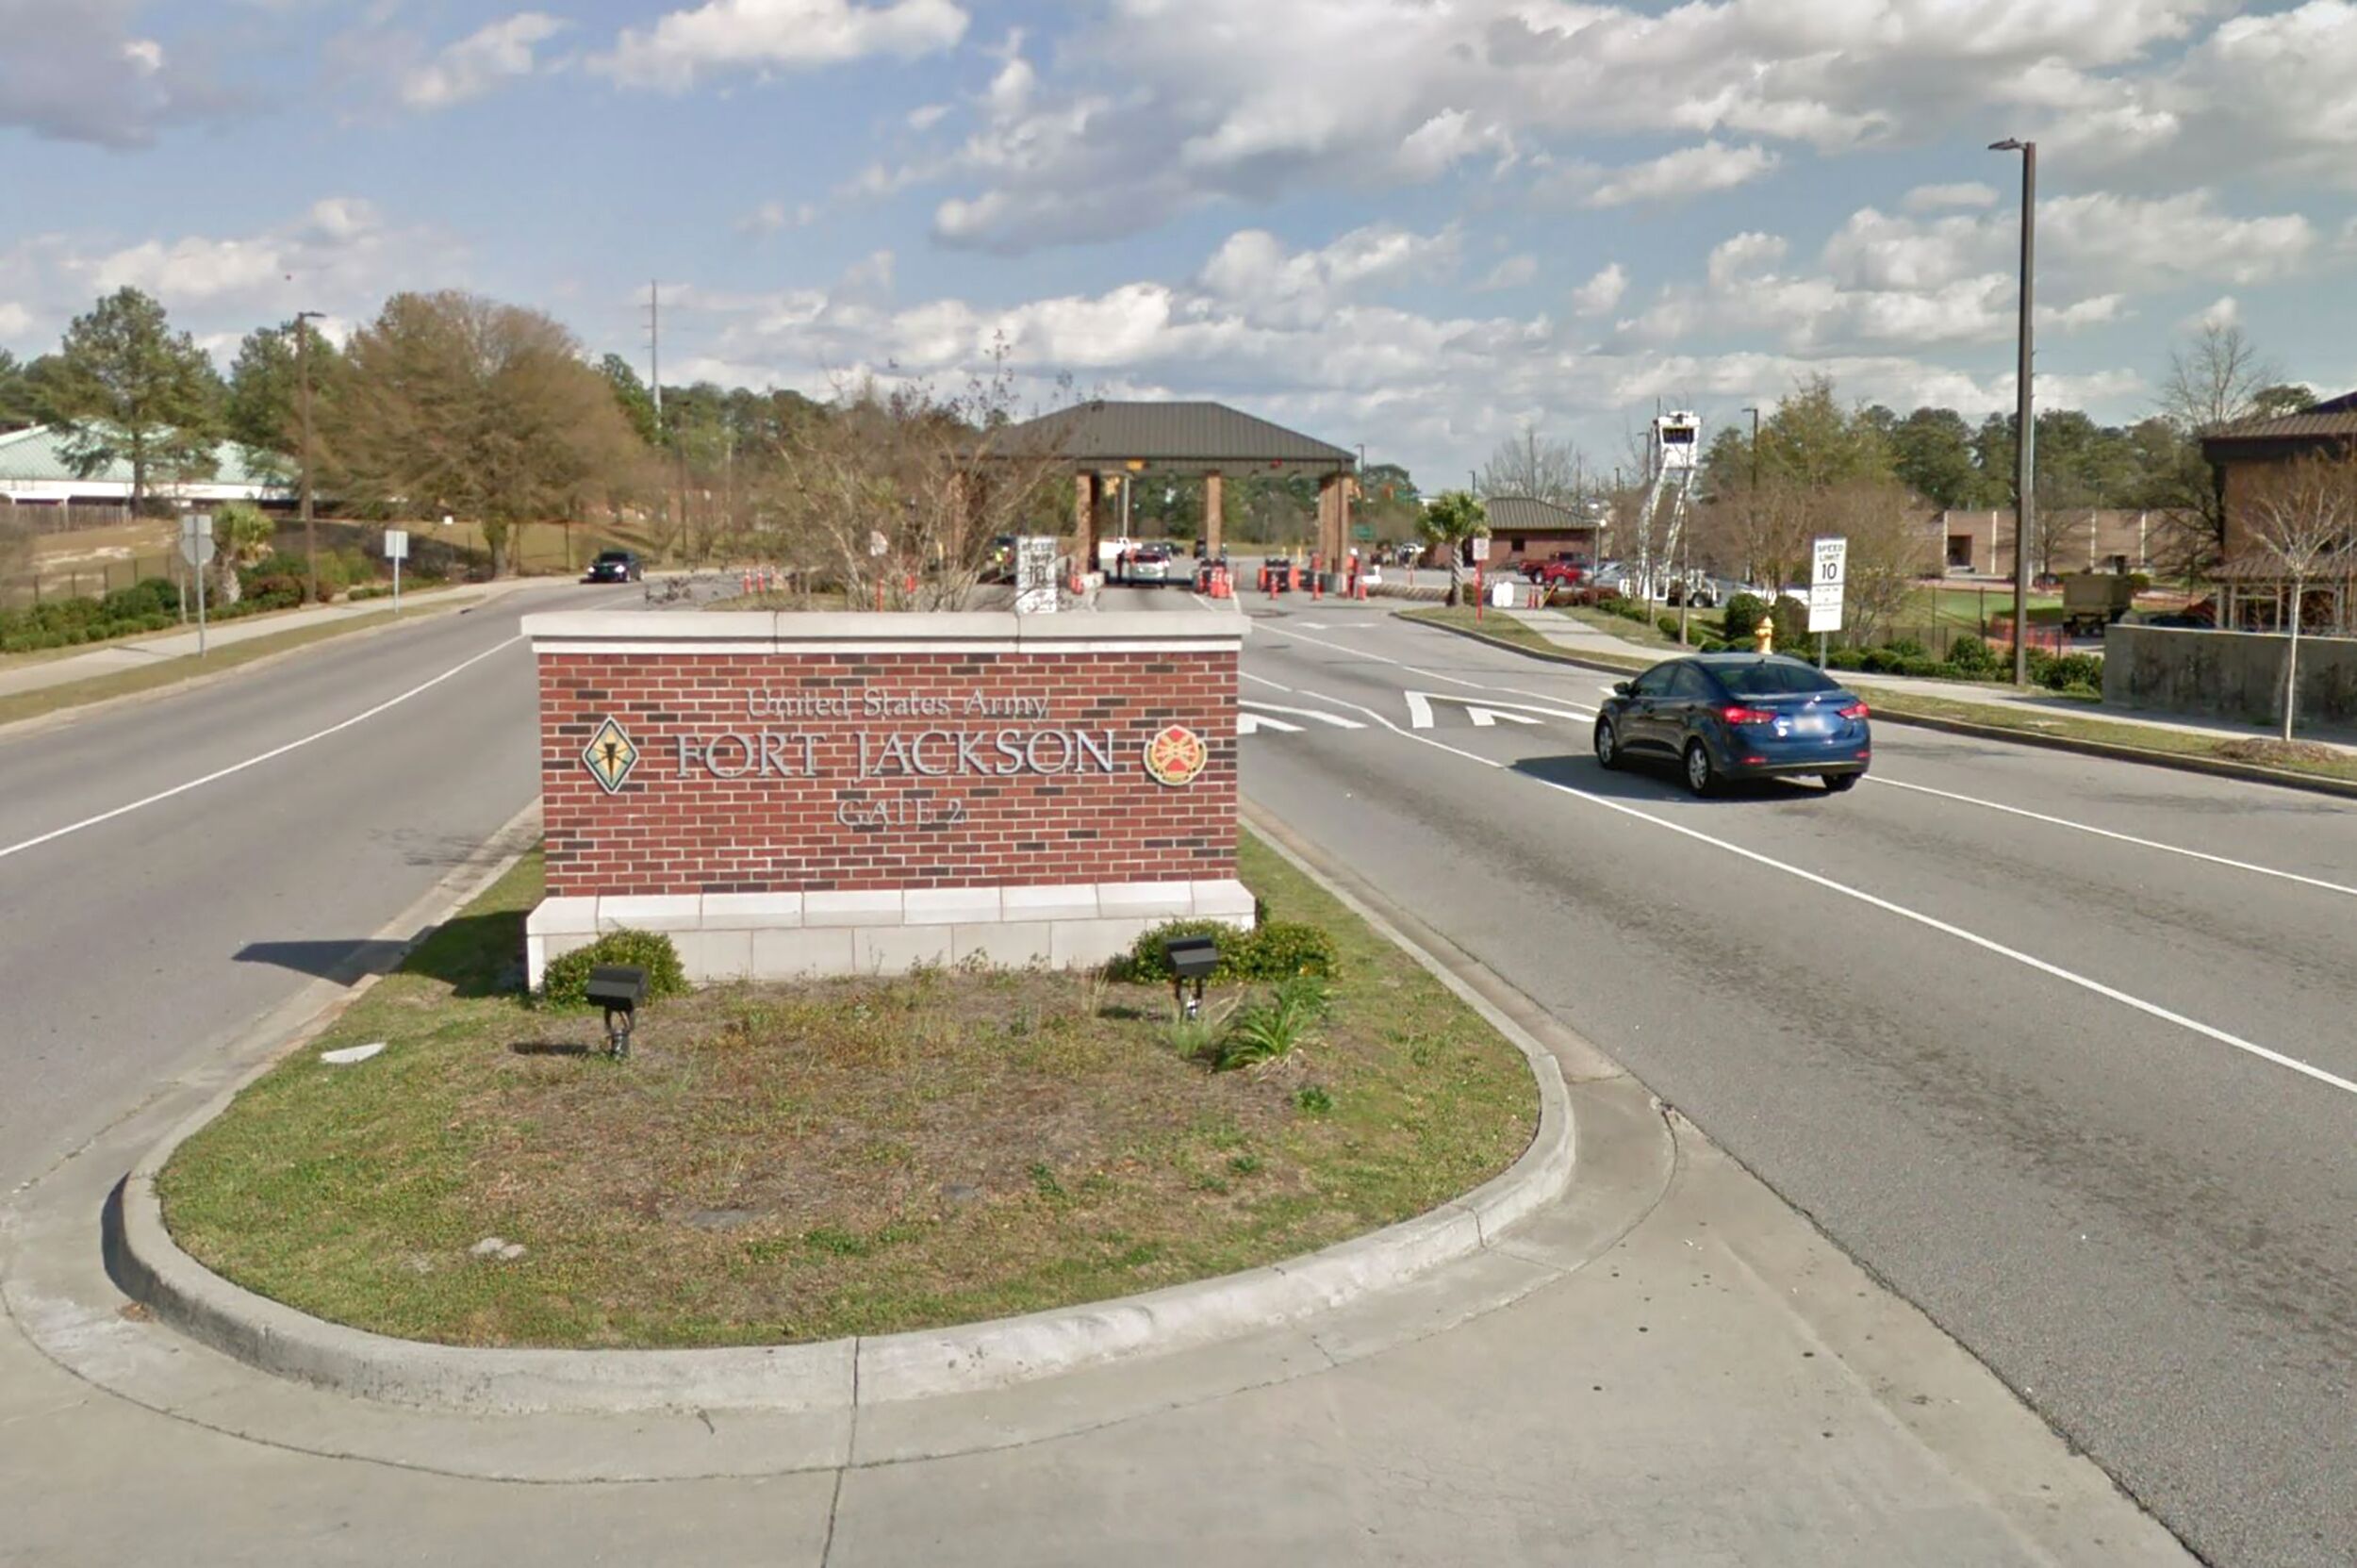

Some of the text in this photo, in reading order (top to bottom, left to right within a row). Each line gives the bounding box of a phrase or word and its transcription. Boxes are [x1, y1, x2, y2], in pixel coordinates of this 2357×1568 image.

[1817, 544, 1844, 553] SPEED
[1819, 553, 1840, 562] LIMIT
[1821, 562, 1838, 580] 10
[746, 687, 1049, 727] United States Army
[675, 728, 1115, 784] FORT JACKSON
[836, 798, 966, 826] GATE 2
